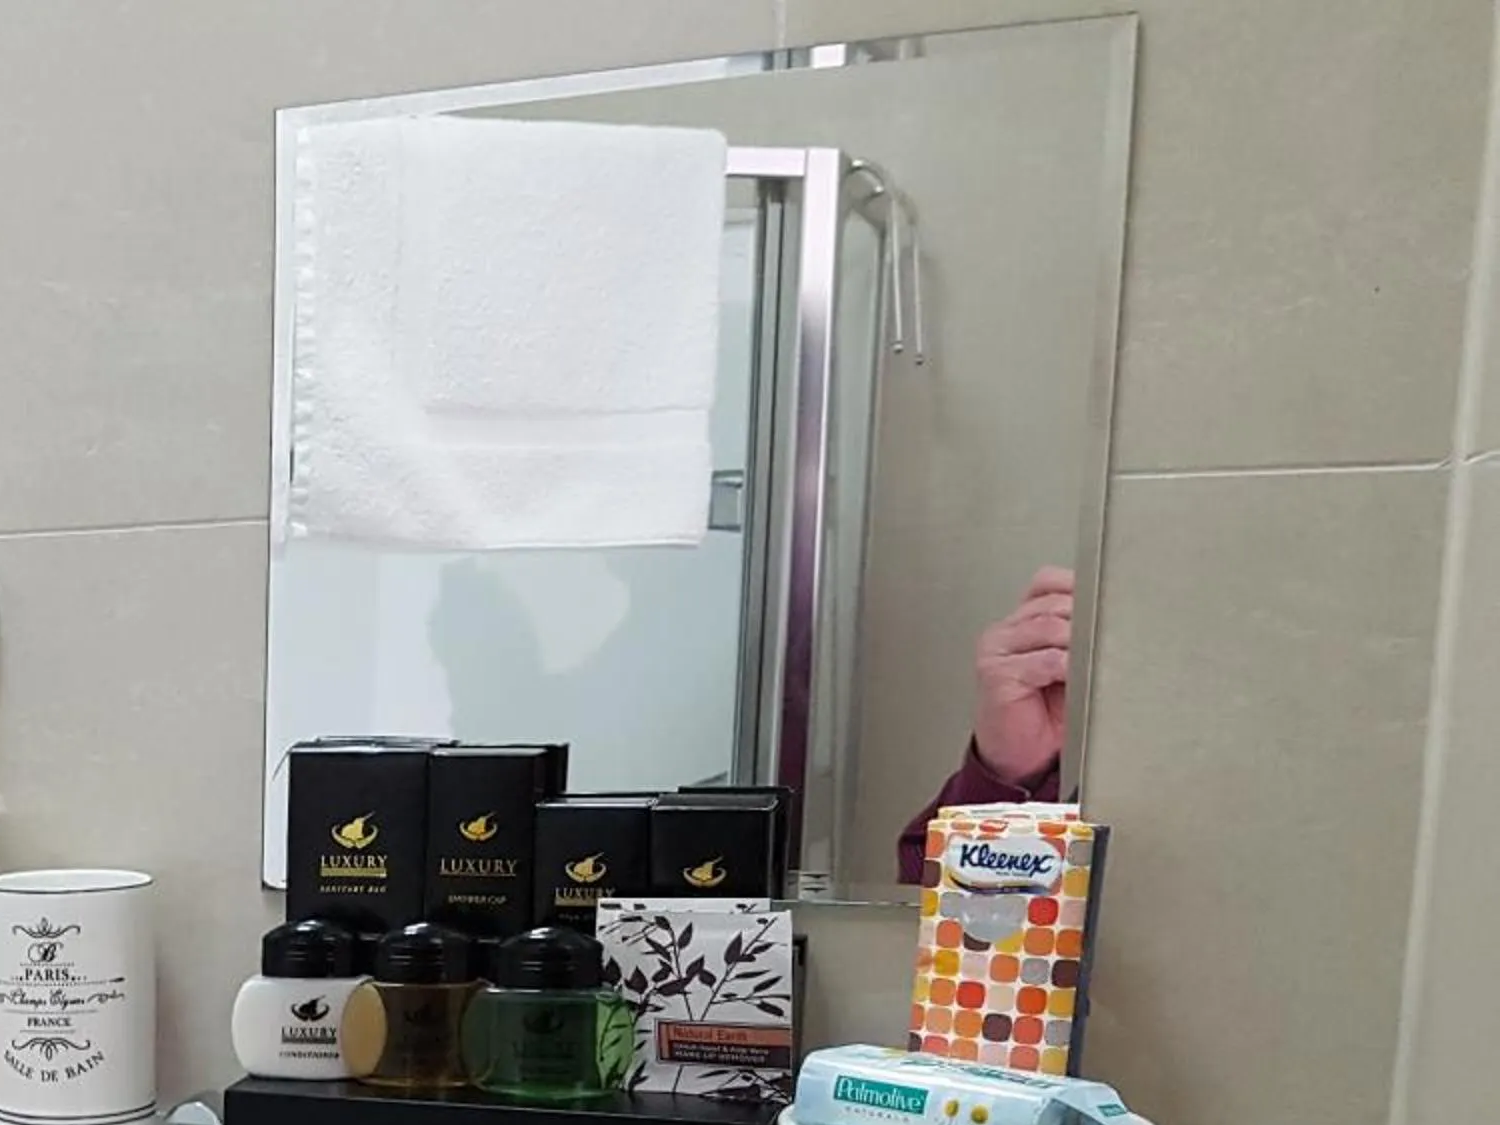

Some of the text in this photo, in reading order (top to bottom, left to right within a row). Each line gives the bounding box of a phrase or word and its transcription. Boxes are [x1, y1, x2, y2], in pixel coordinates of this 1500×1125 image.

[320, 854, 388, 867] LUXURY
[440, 857, 517, 873] LUXURY
[959, 843, 1055, 877] Kleenex
[555, 887, 616, 900] LUXURY
[25, 968, 70, 980] PARIS
[27, 1017, 72, 1027] FRANCE
[282, 1026, 337, 1039] LUXURY
[4, 1049, 104, 1082] SALLE DE BAIN
[836, 1077, 922, 1111] Palmolive
